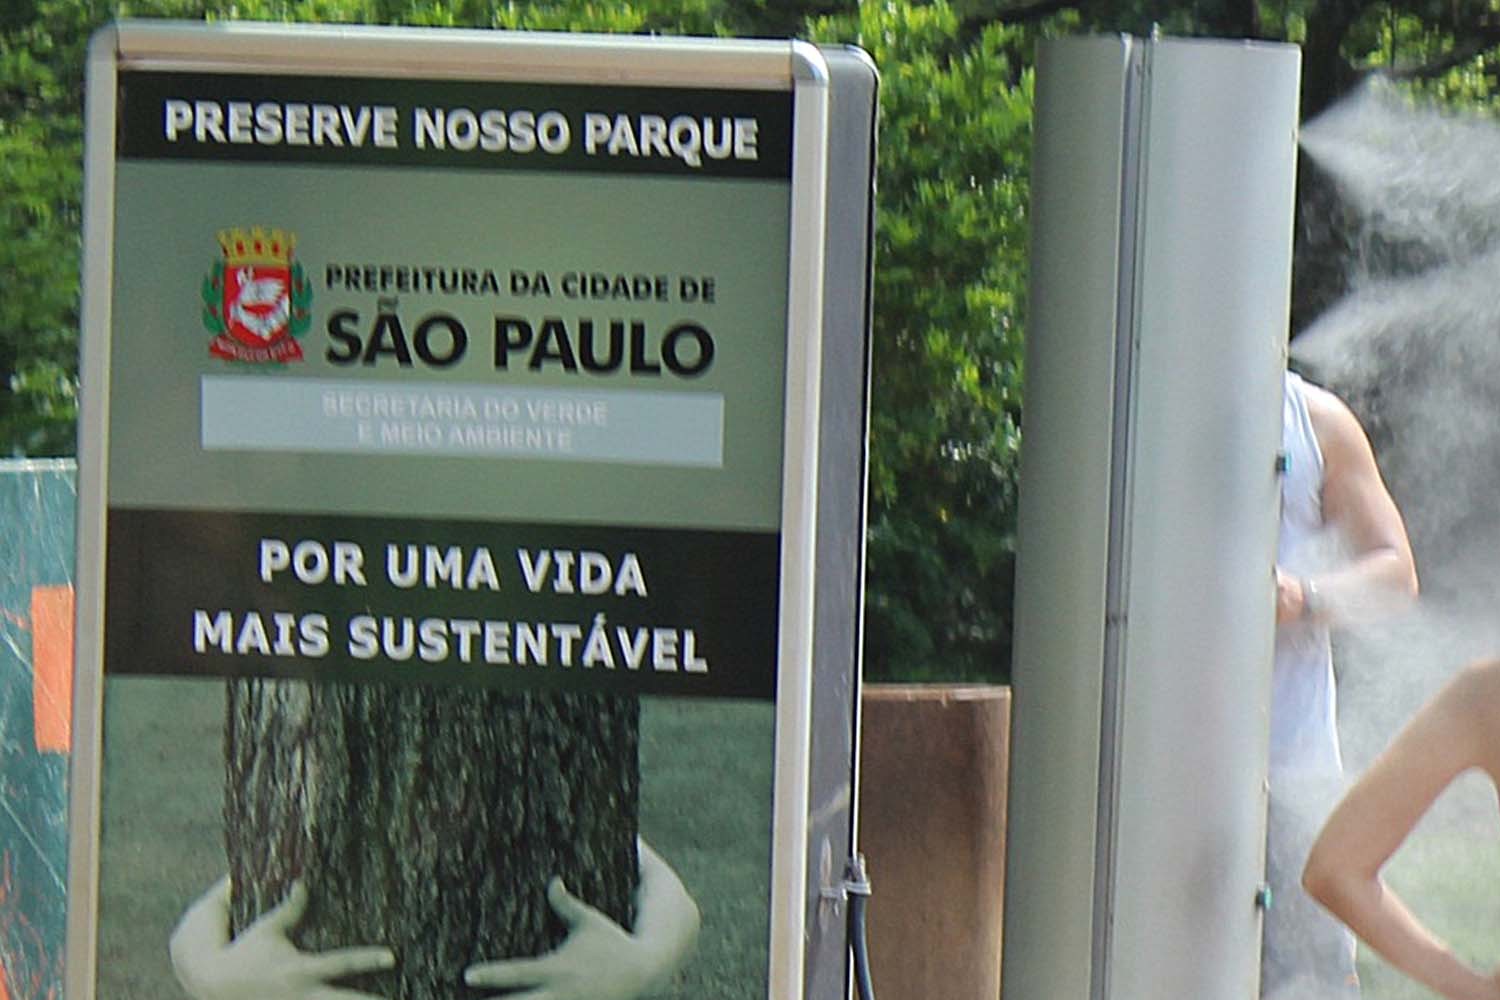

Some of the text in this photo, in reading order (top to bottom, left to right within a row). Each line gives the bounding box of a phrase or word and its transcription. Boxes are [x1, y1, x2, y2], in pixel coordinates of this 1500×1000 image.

[165, 99, 758, 167] PRESERVE NOSSO PARQUE
[326, 264, 716, 304] PREFEITURA DA CIDADE DE
[325, 297, 715, 379] SÃO PAULO
[321, 391, 608, 428] SECRETARIA DO VERDE
[358, 421, 574, 452] E MEIO AMBIENTE
[260, 538, 648, 597] POR UMA VIDA
[194, 609, 709, 673] MAIS SUSTENTÁVEL
